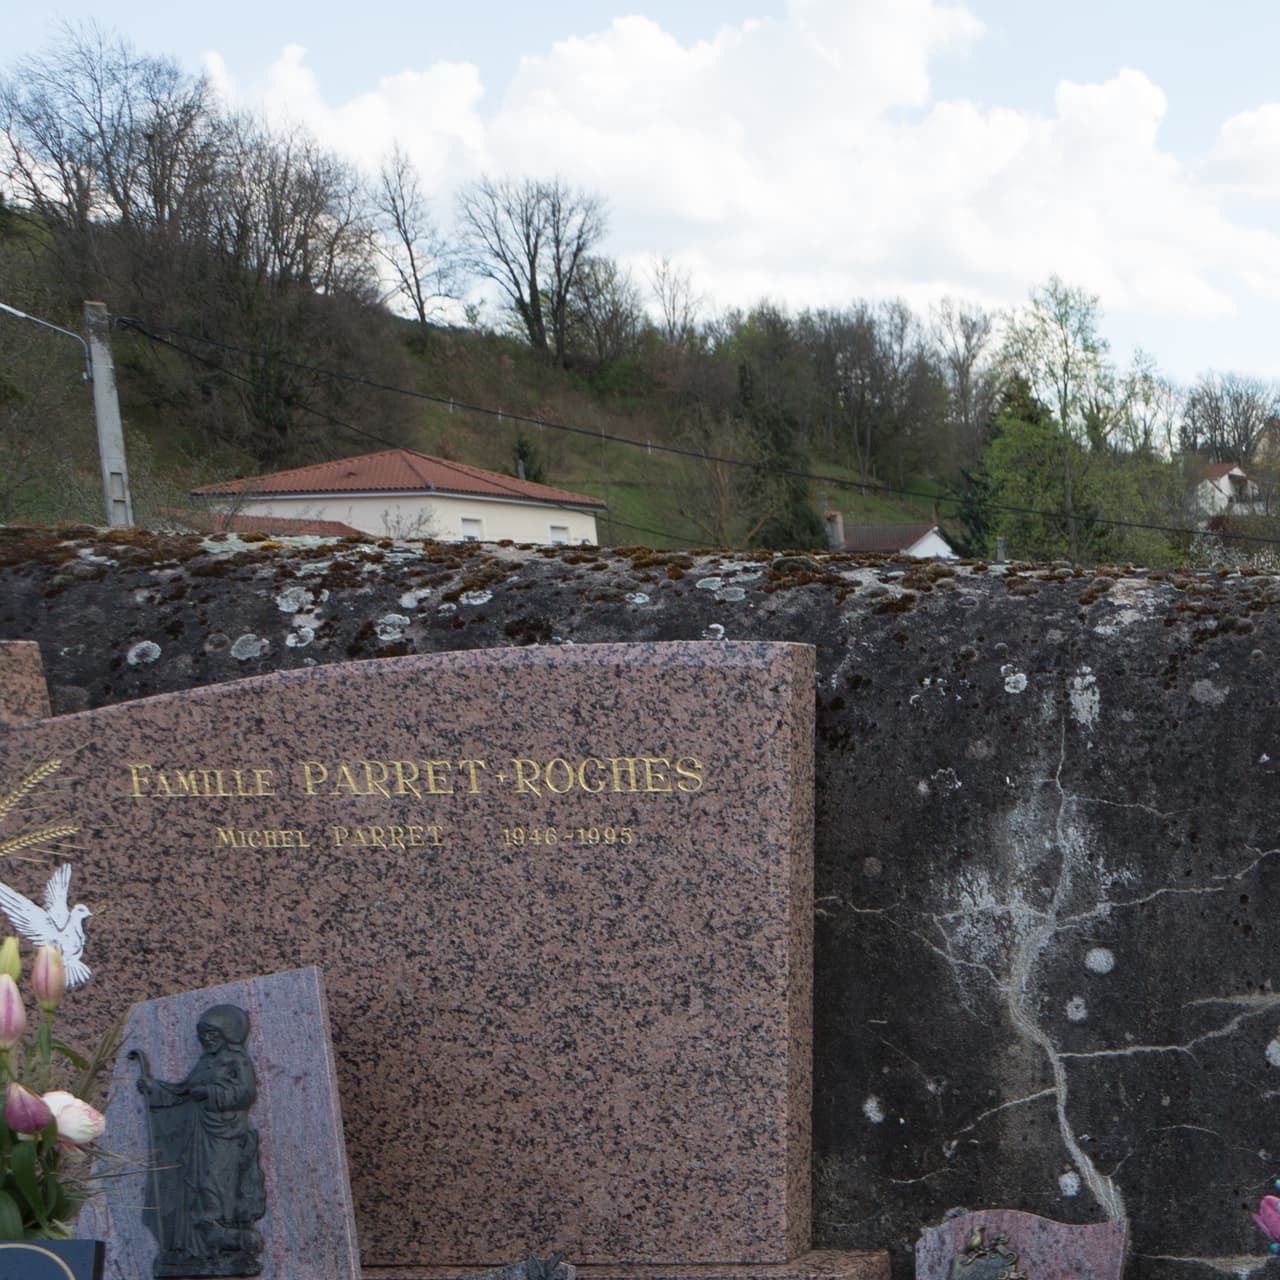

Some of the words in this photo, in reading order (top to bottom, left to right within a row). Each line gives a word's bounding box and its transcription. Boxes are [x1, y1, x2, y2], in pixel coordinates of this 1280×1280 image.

[128, 763, 275, 797] FAMILLE
[216, 826, 310, 848] MICHEL
[331, 825, 443, 850] PARRET
